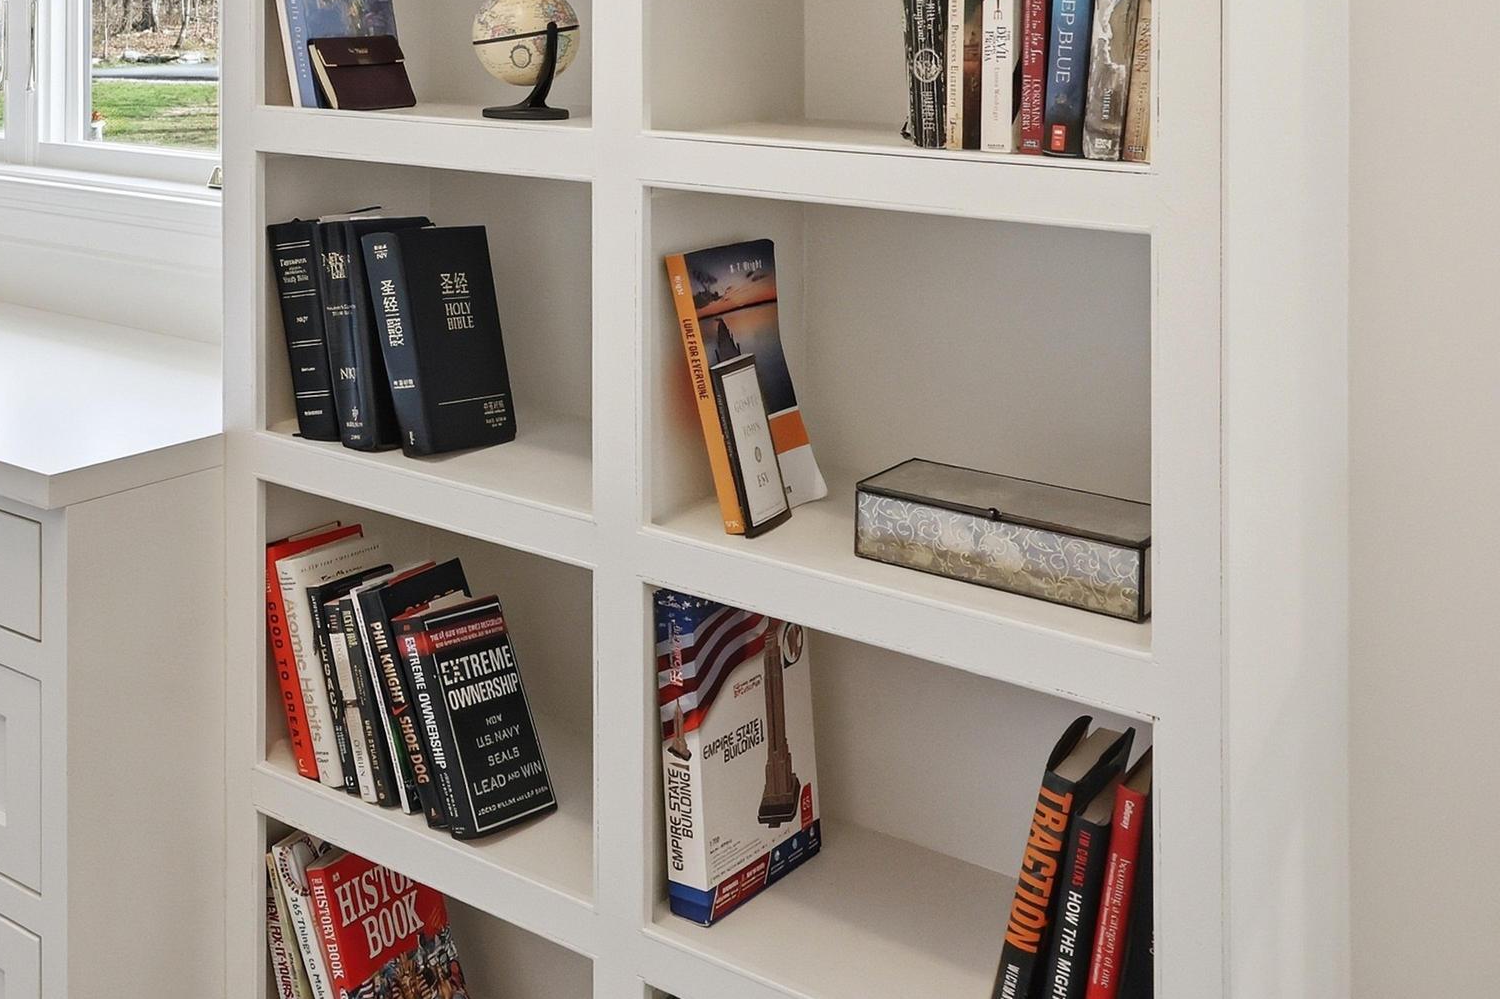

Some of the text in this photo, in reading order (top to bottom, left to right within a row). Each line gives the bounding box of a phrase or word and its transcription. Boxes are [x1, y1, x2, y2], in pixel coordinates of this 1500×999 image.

[983, 31, 994, 62] PRADA
[996, 26, 1009, 63] DEVIL
[1054, 27, 1073, 84] BLUE
[1021, 75, 1031, 132] HANSBERRY
[1031, 79, 1041, 129] LORRAINE
[439, 272, 470, 295] 圣经
[444, 302, 471, 316] HOLY
[447, 315, 476, 331] BIBLE
[682, 317, 709, 401] LUKE FOR EVERYONE
[268, 600, 303, 749] GOOD TO GREAT
[286, 598, 308, 671] Atomic
[300, 676, 322, 745] Habits
[318, 634, 340, 721] LEGACY
[440, 644, 514, 688] EXTREME
[370, 621, 429, 785] PHIL KNIGHT SHOE DOG
[404, 636, 447, 770] EXTREME OWNERSHIP
[448, 672, 519, 712] OWNERSHIP
[353, 738, 366, 777] O'BRIEN
[364, 720, 379, 771] BEN STUART
[486, 746, 520, 767] SEALS
[494, 724, 520, 745] NAVY
[702, 717, 761, 761] EMPIRE STATE
[723, 735, 761, 764] BUILDING
[473, 771, 507, 796] LEAD
[521, 759, 543, 779] WIN
[668, 766, 684, 872] EMPIRE STATE
[681, 772, 694, 839] BUILDING
[1005, 786, 1074, 954] TRACTION
[334, 864, 416, 928] HISTO
[1066, 890, 1083, 926] HOW
[290, 896, 302, 916] 365
[297, 916, 314, 955] Things
[313, 884, 345, 979] HISTORY BOOK
[362, 889, 425, 960] BOOK
[1060, 926, 1077, 957] THE
